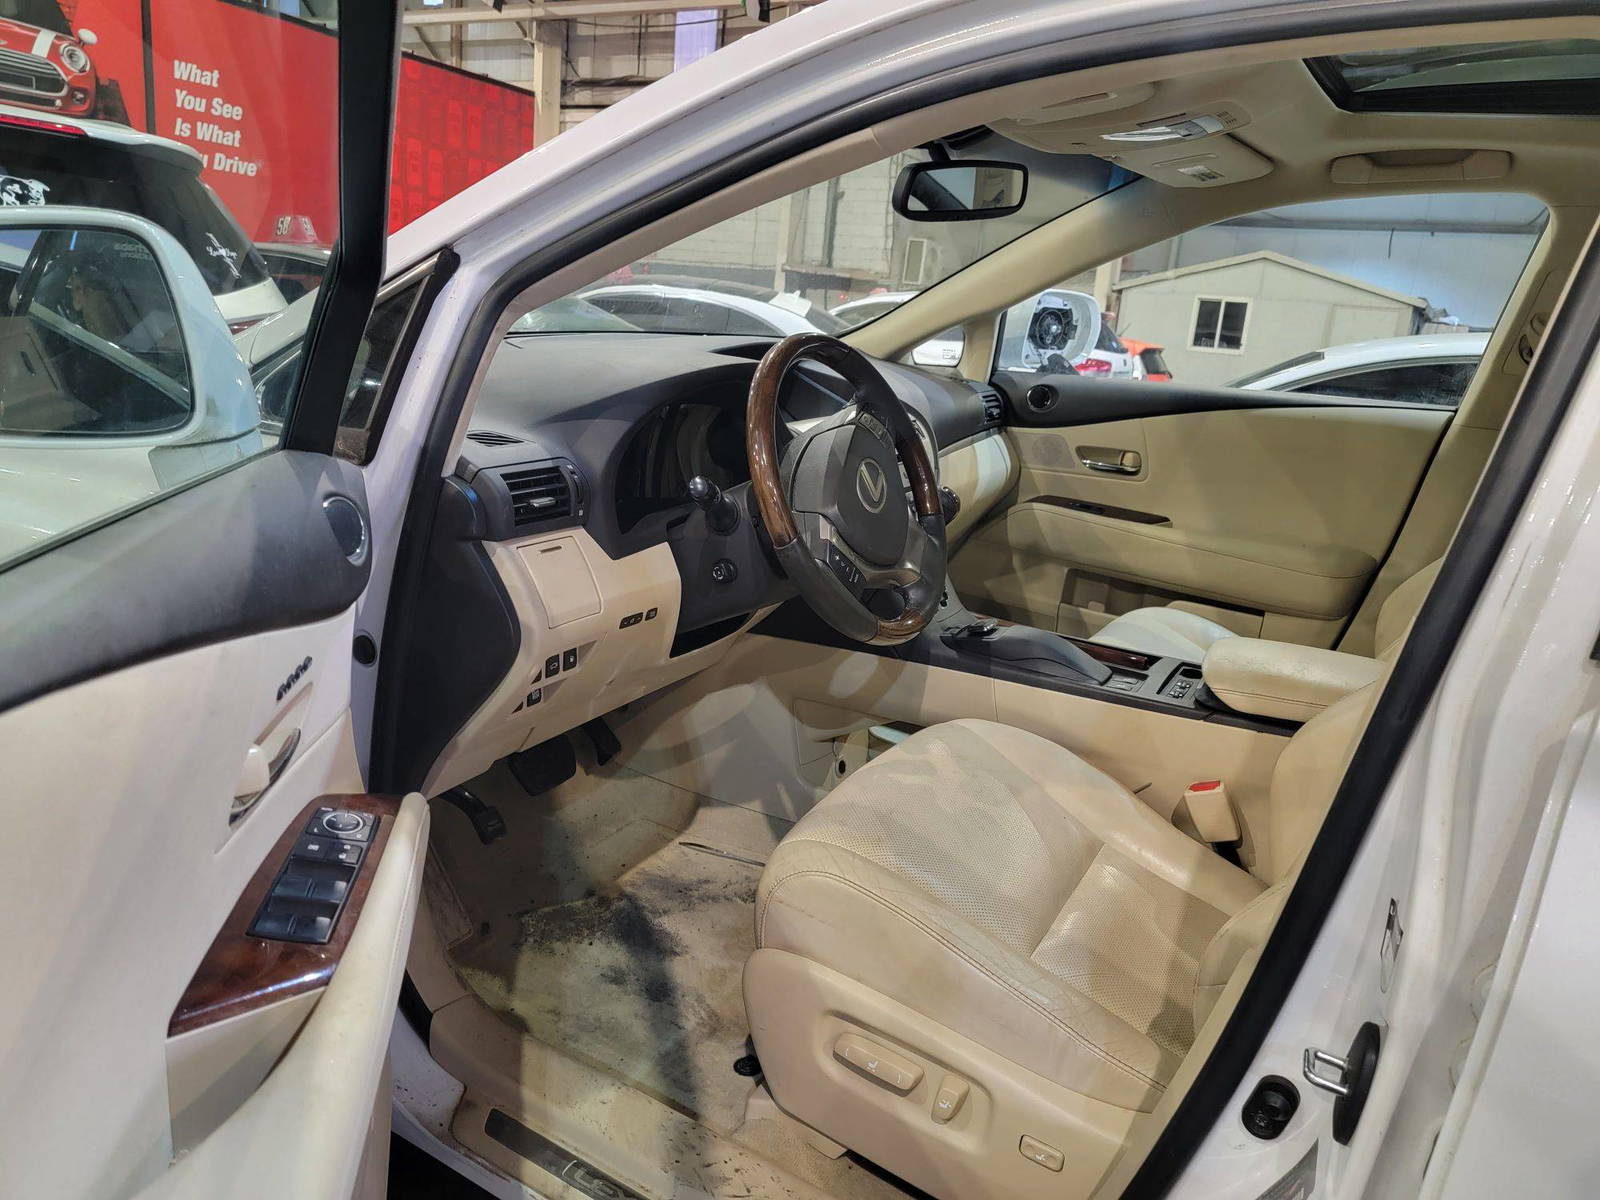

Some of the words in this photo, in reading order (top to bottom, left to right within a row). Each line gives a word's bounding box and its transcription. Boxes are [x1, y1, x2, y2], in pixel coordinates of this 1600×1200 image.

[174, 60, 219, 88] What
[175, 89, 206, 112] You
[211, 97, 243, 120] See
[174, 118, 192, 137] Is
[196, 121, 241, 148] What
[213, 152, 257, 177] Drive
